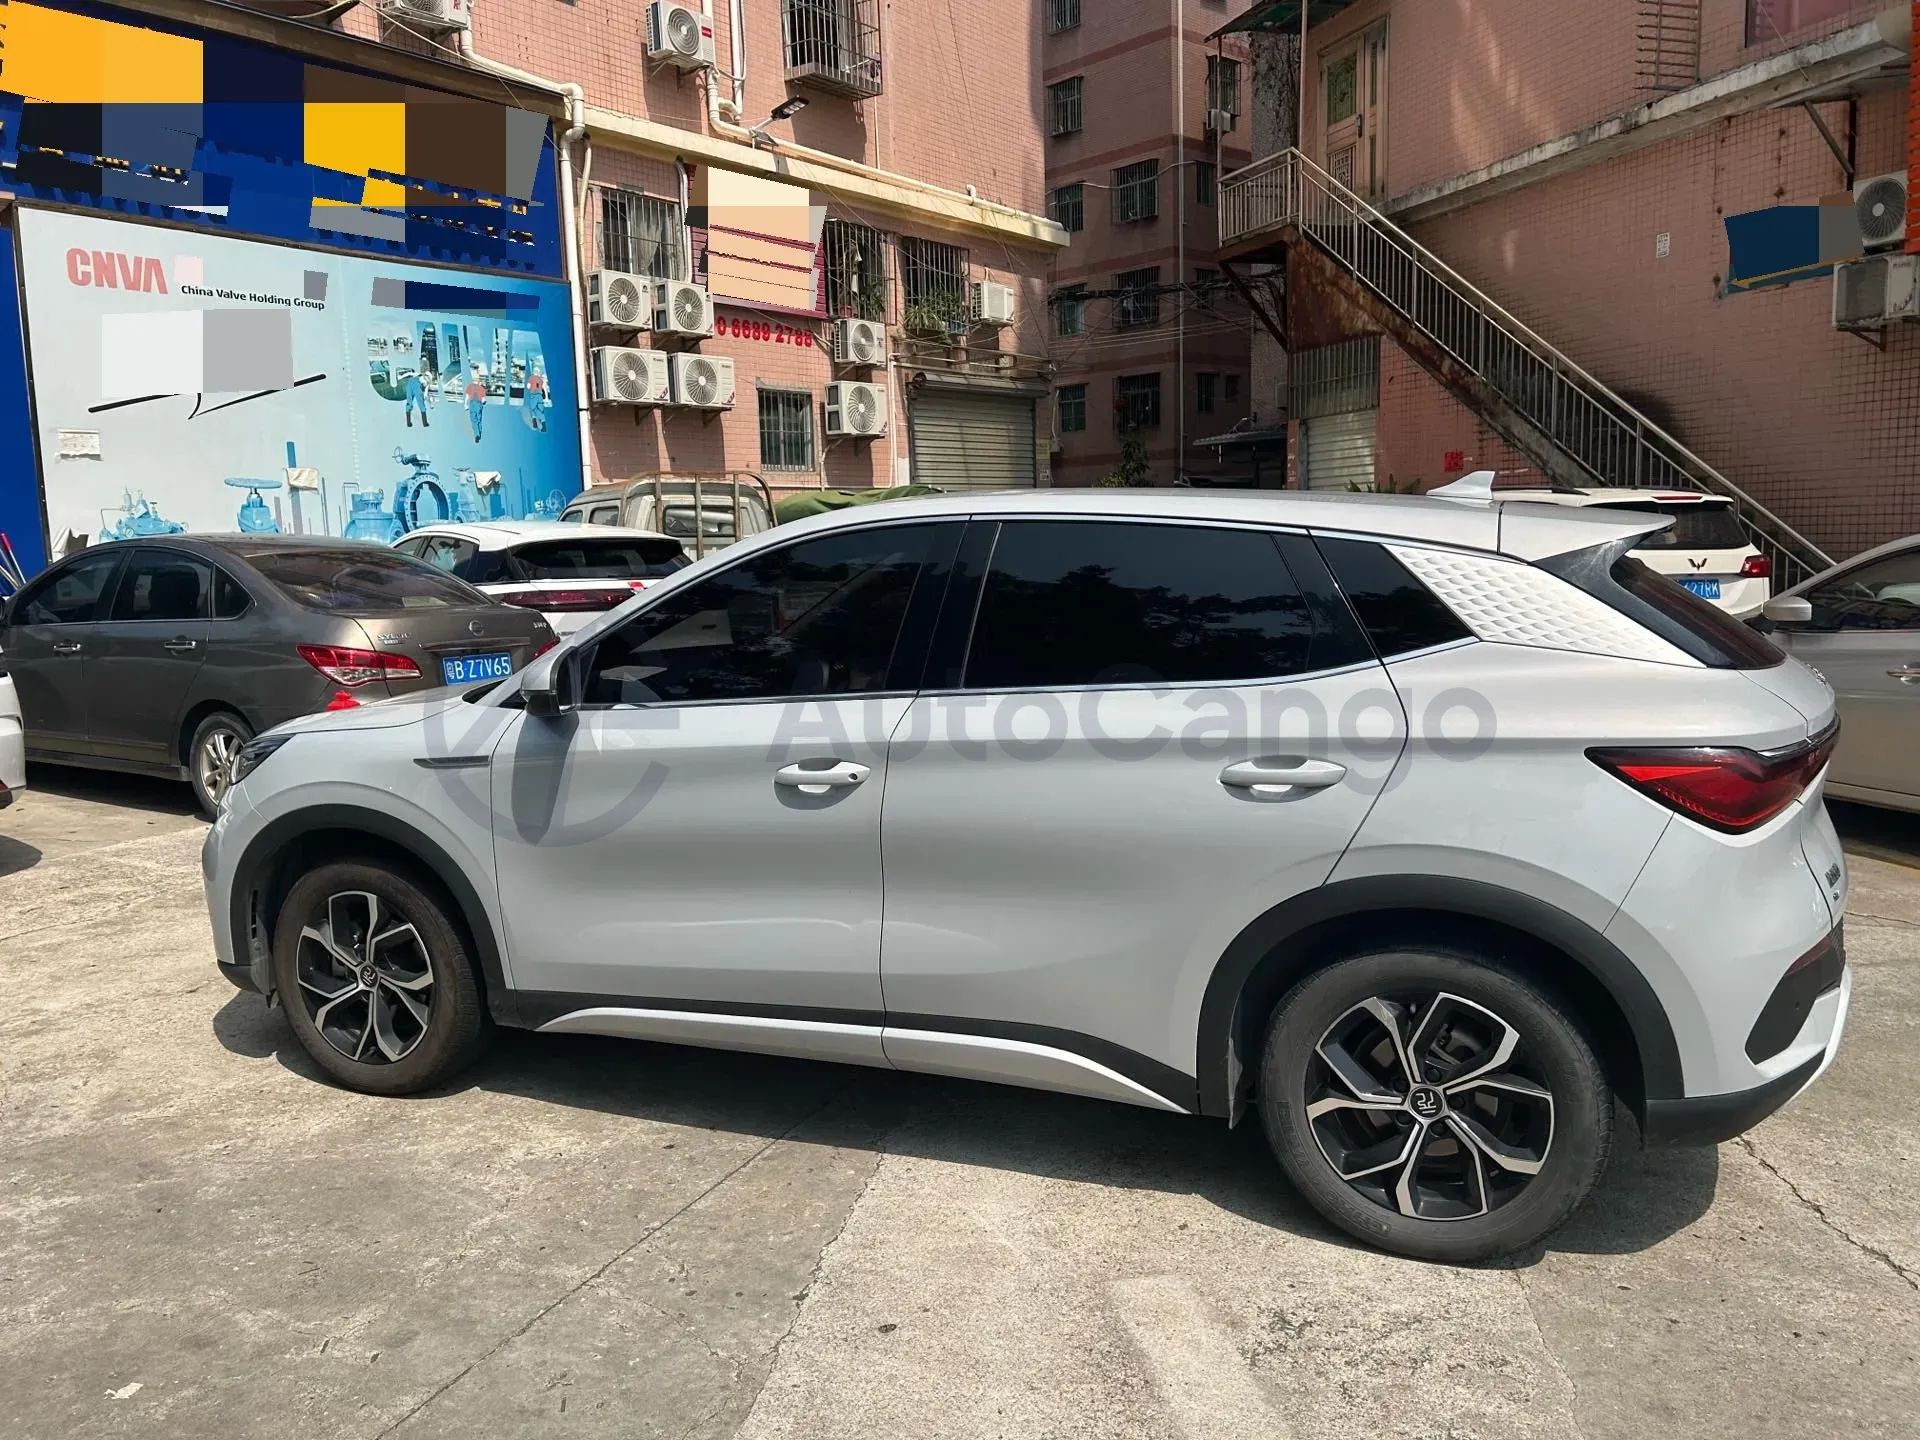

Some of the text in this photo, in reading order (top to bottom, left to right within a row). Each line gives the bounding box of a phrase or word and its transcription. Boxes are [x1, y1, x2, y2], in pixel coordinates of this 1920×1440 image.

[66, 247, 168, 294] CNVA
[181, 285, 326, 311] China Valve Holding Group
[731, 317, 770, 342] 6689
[775, 322, 813, 348] 2788
